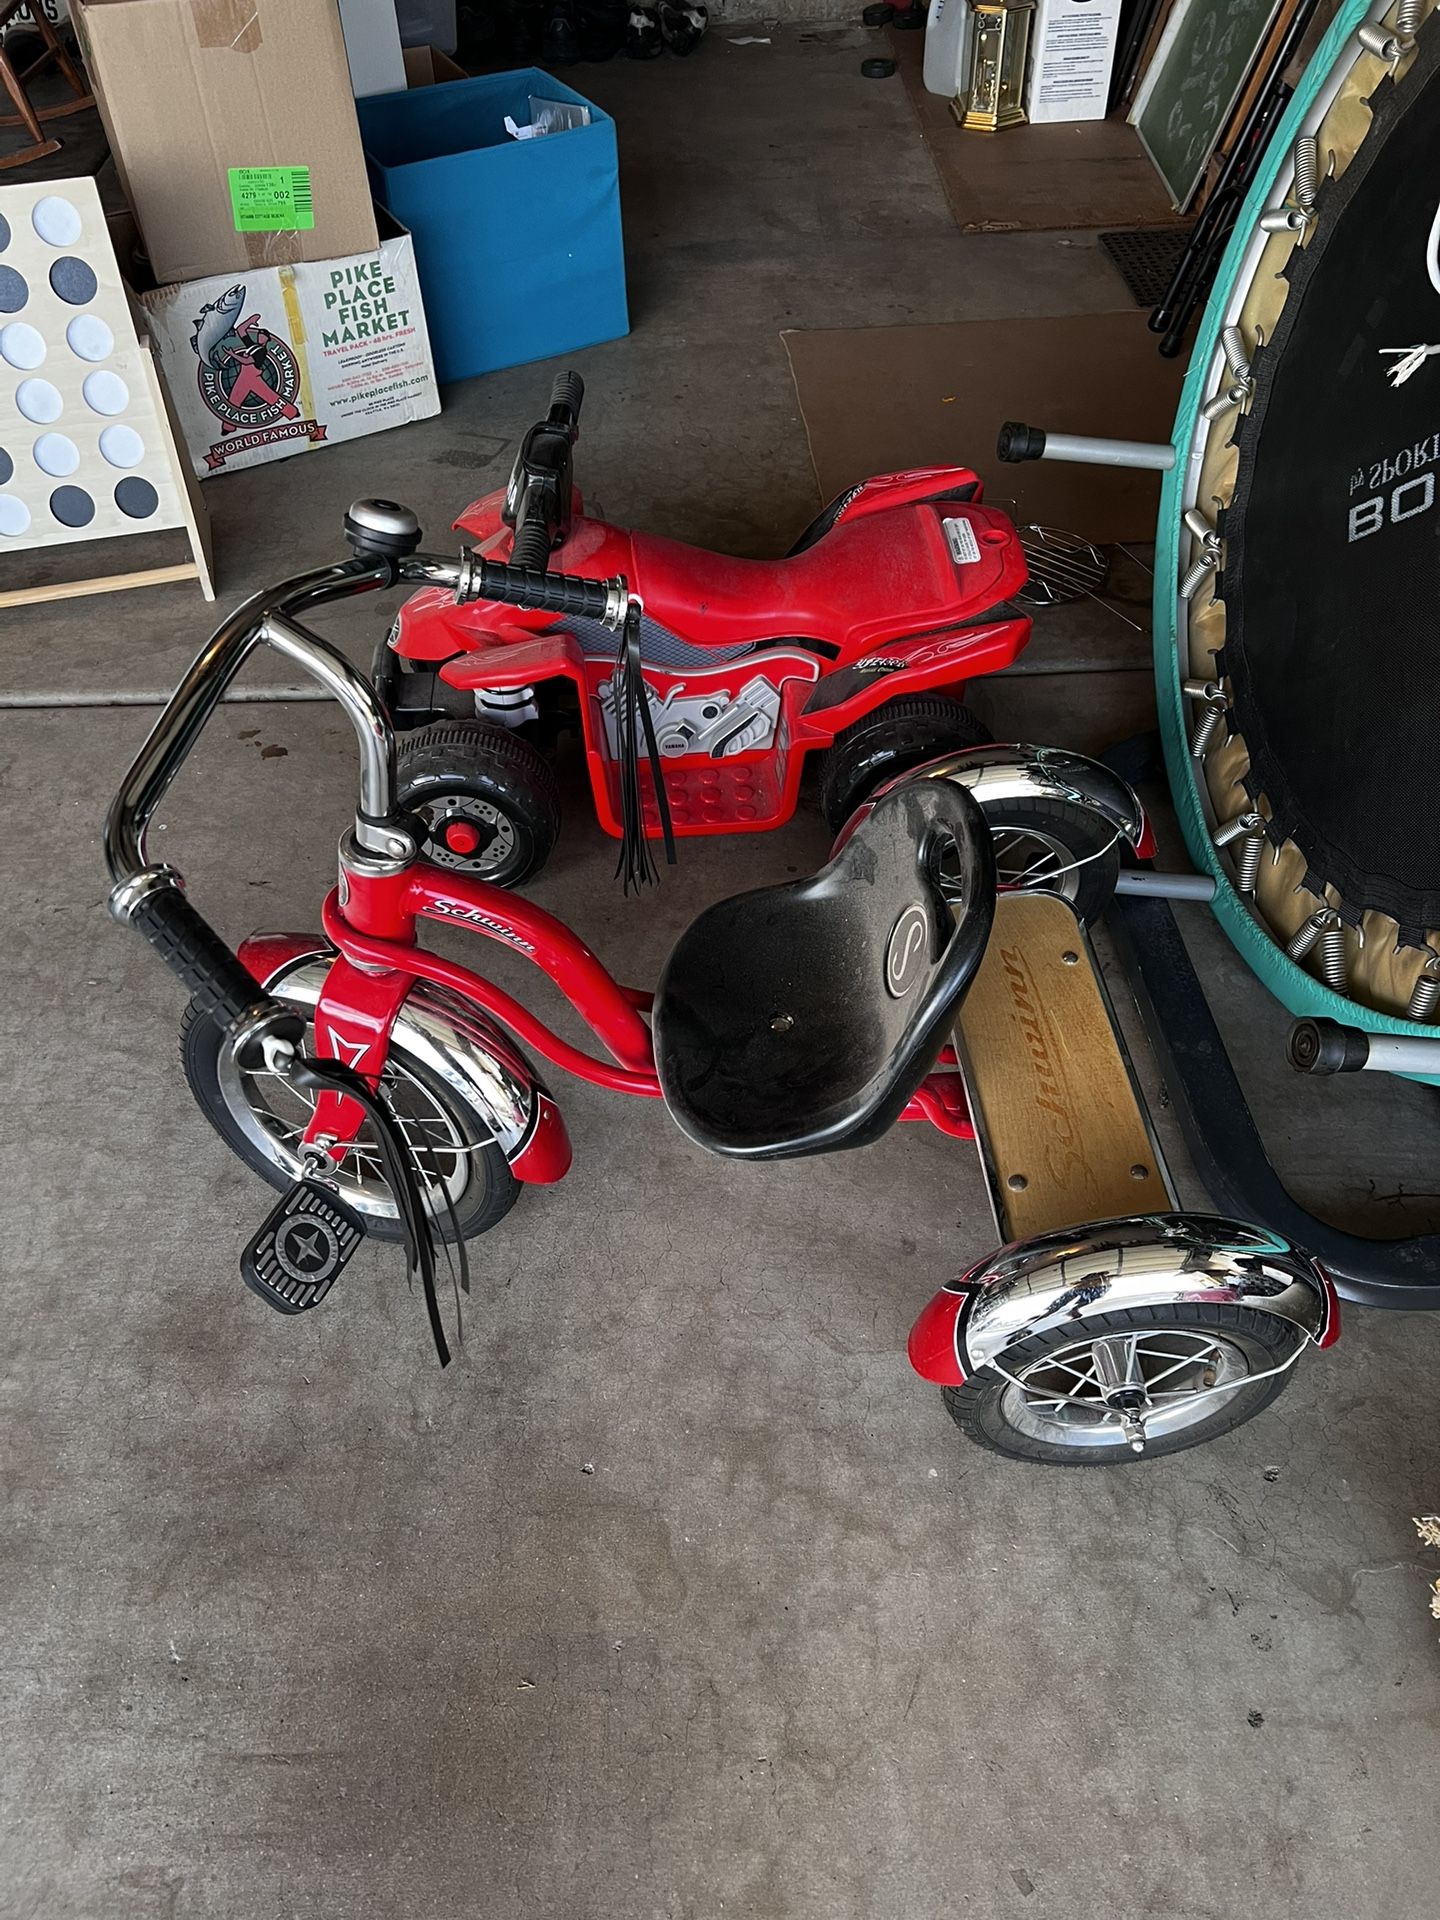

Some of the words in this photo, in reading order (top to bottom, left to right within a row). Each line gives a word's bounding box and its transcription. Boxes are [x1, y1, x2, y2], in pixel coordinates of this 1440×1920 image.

[241, 191, 257, 199] 4279
[274, 190, 290, 199] 002
[330, 260, 382, 289] PIKE
[324, 276, 396, 309] PLACE
[339, 297, 388, 325] FISH
[322, 309, 409, 348] MARKET
[323, 347, 350, 357] TRAVEL
[350, 340, 369, 350] PACK
[395, 327, 416, 337] FRESH
[204, 372, 221, 404] PIKE
[270, 345, 295, 399] MARKET
[329, 375, 429, 407] www.pikeplacefish.com
[218, 403, 257, 423] PLACE
[260, 398, 287, 421] FISH
[214, 434, 260, 455] WORLD
[262, 422, 315, 442] FAMOUS
[422, 899, 536, 953] Schwinn
[1000, 945, 1099, 1211] Schwinn
